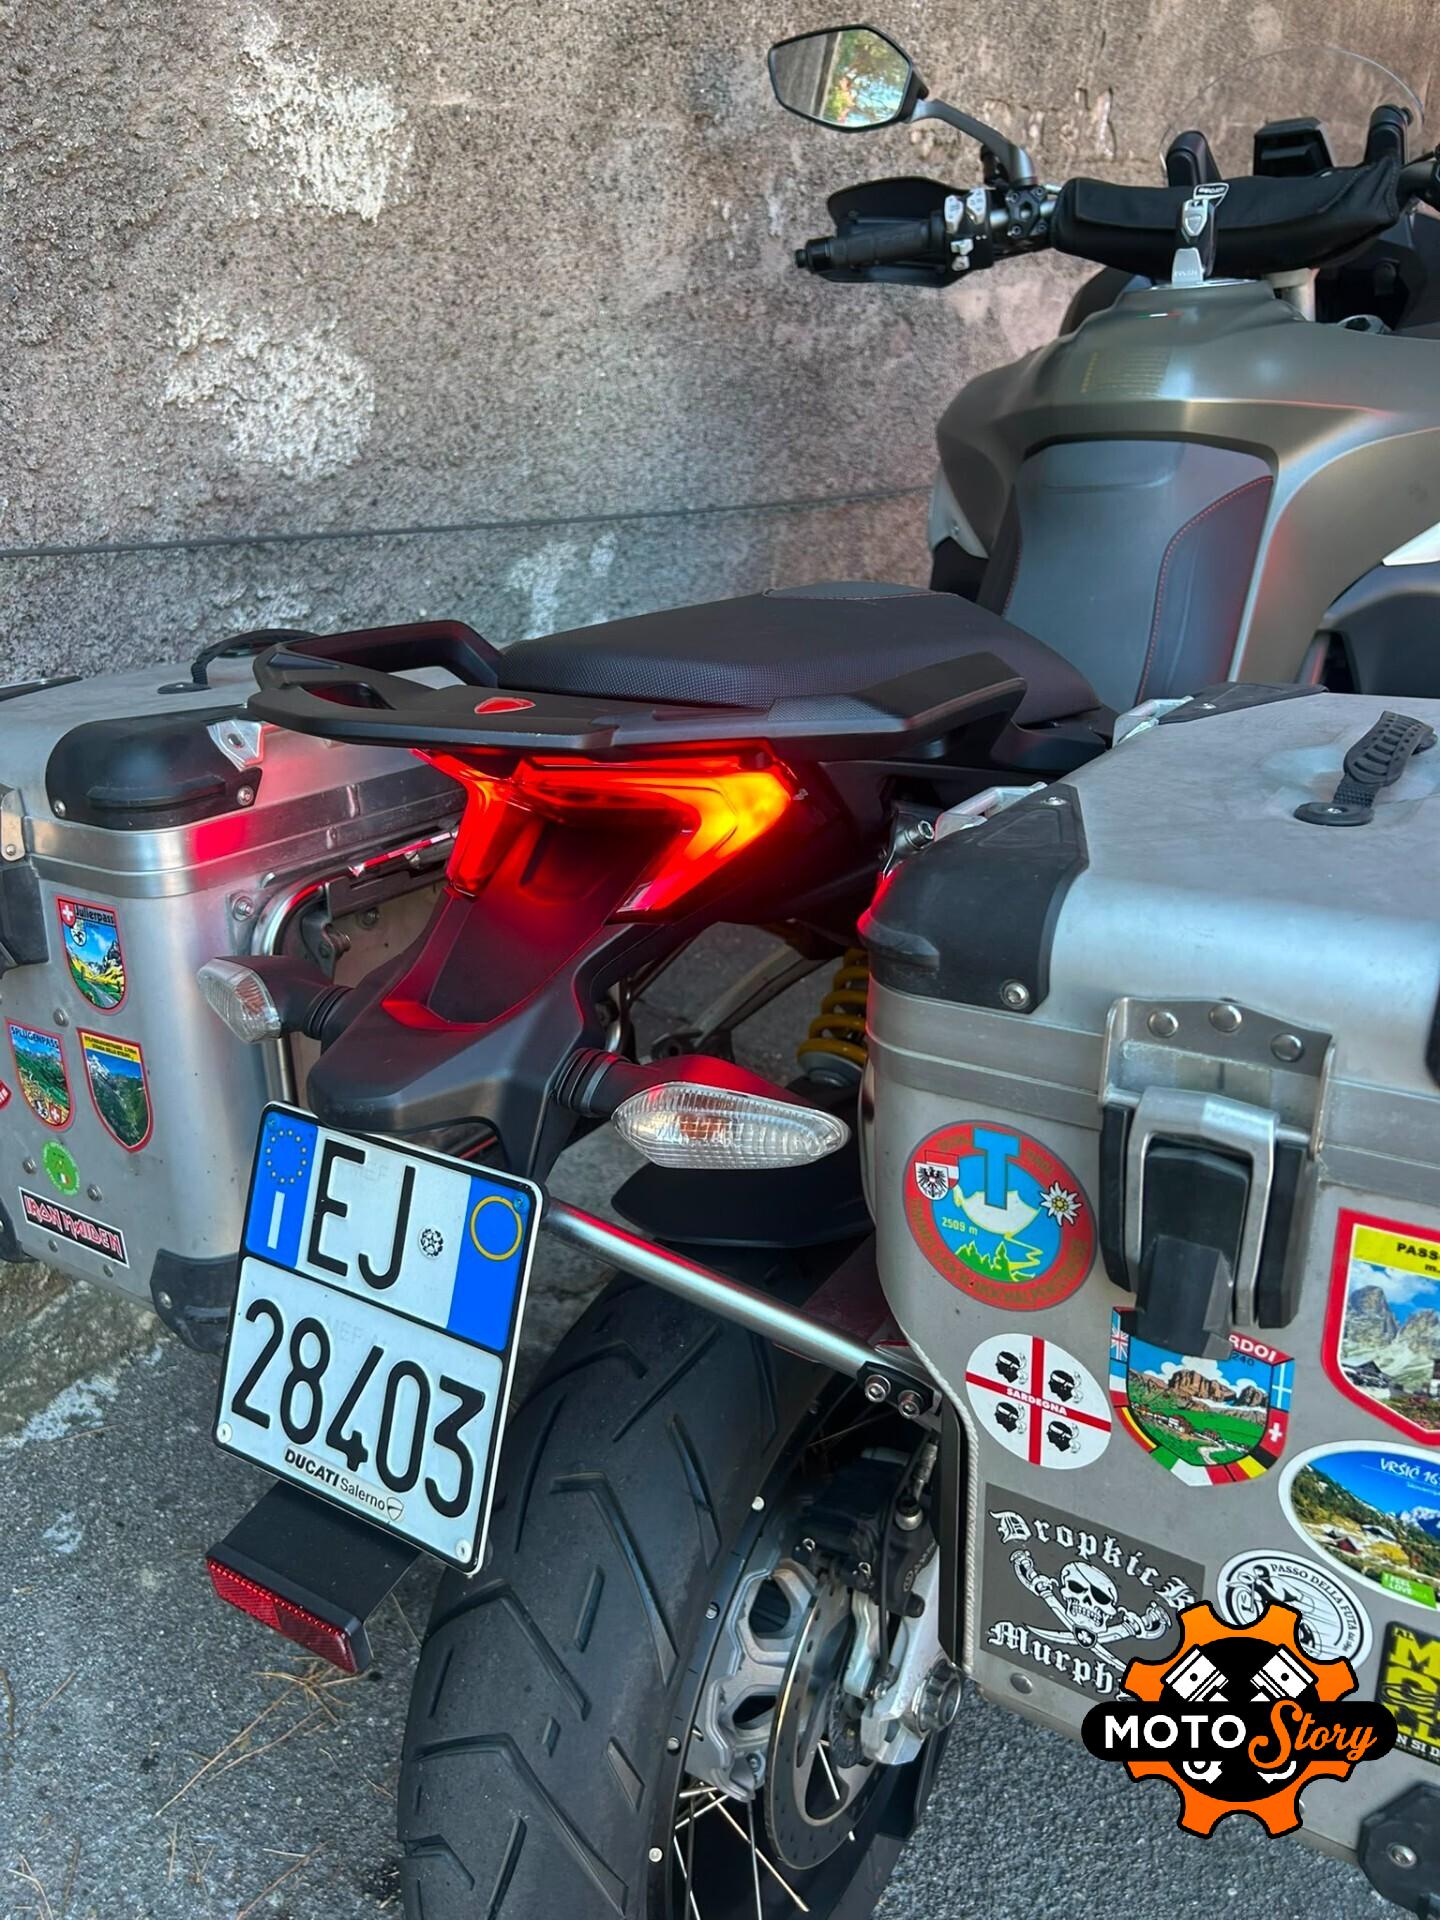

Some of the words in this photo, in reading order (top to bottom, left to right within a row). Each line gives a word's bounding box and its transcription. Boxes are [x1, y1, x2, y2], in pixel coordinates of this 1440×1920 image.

[24, 1194, 63, 1232] IRON
[60, 1211, 124, 1259] MAIDEN
[306, 1138, 416, 1290] EJ
[941, 1216, 967, 1233] 2509
[968, 1226, 978, 1235] m
[1396, 1241, 1440, 1261] PASS
[1228, 1334, 1277, 1363] RDOI
[1229, 1351, 1256, 1367] 240
[231, 1297, 485, 1518] 28403
[1006, 1387, 1068, 1416] SARDEGNA
[284, 1448, 340, 1487] DUCATI
[339, 1477, 386, 1511] Salerno
[1423, 1471, 1440, 1486] 16
[1270, 1562, 1309, 1579] PASSO
[1310, 1574, 1343, 1604] DELLA
[1340, 1604, 1358, 1631] FUTA
